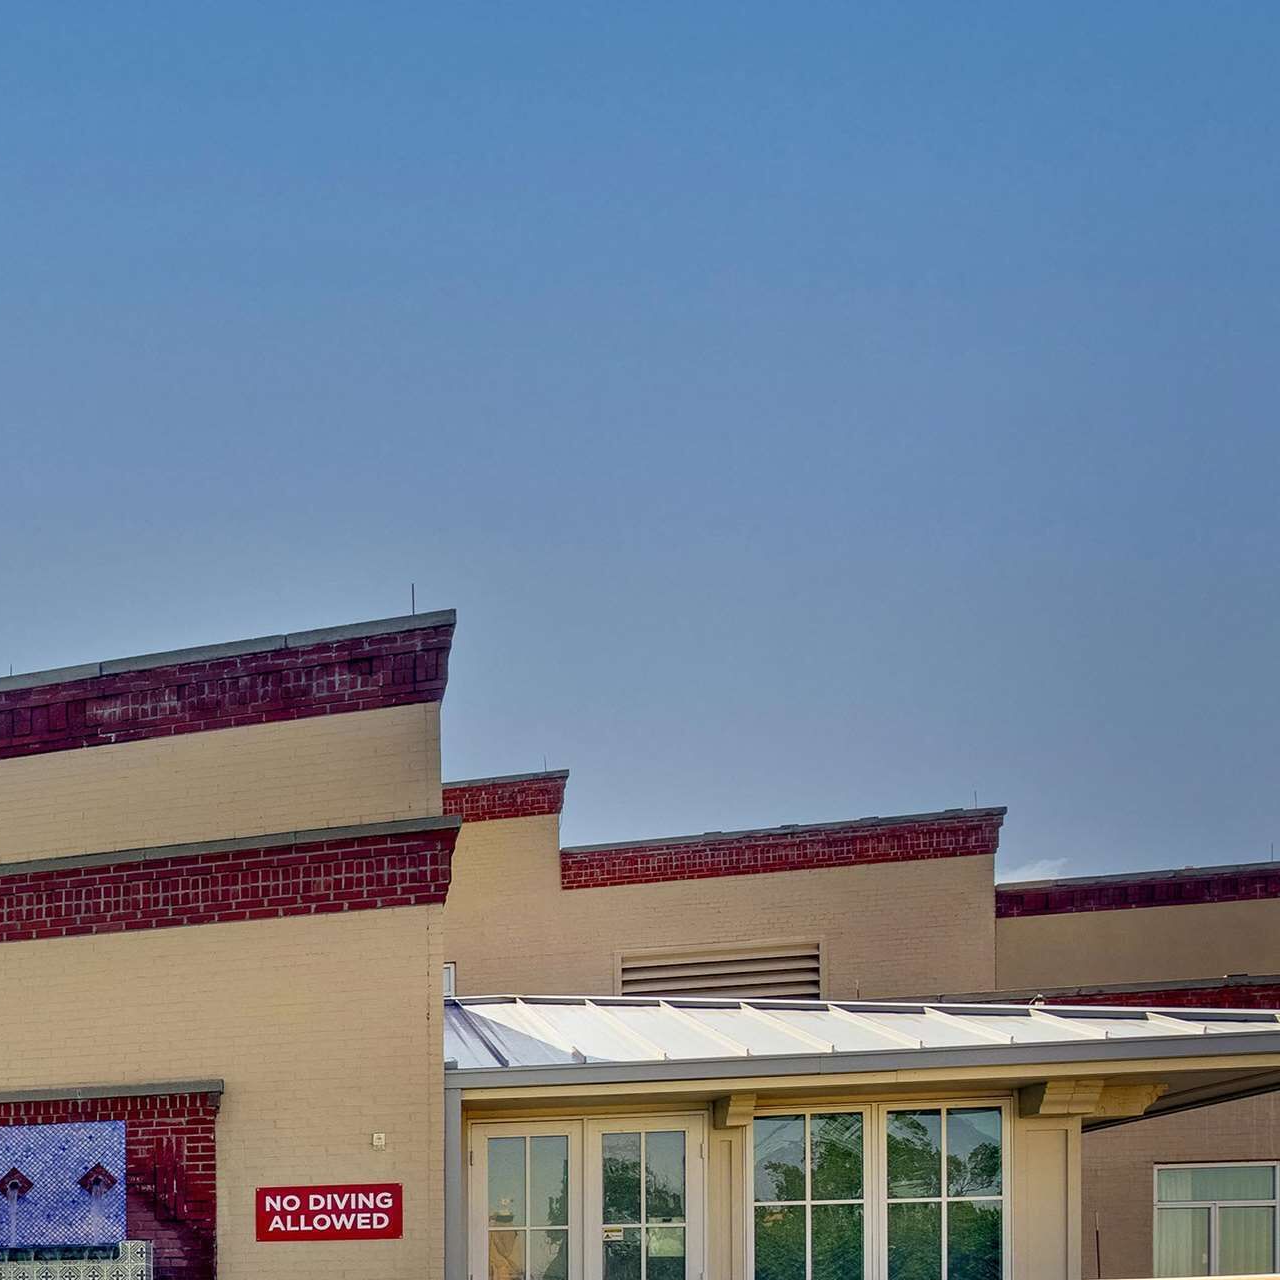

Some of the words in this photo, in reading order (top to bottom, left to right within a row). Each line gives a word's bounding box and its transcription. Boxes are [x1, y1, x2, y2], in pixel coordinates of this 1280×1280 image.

[265, 1195, 301, 1212] NO
[309, 1192, 393, 1211] DIVING
[268, 1213, 390, 1232] ALLOWED
